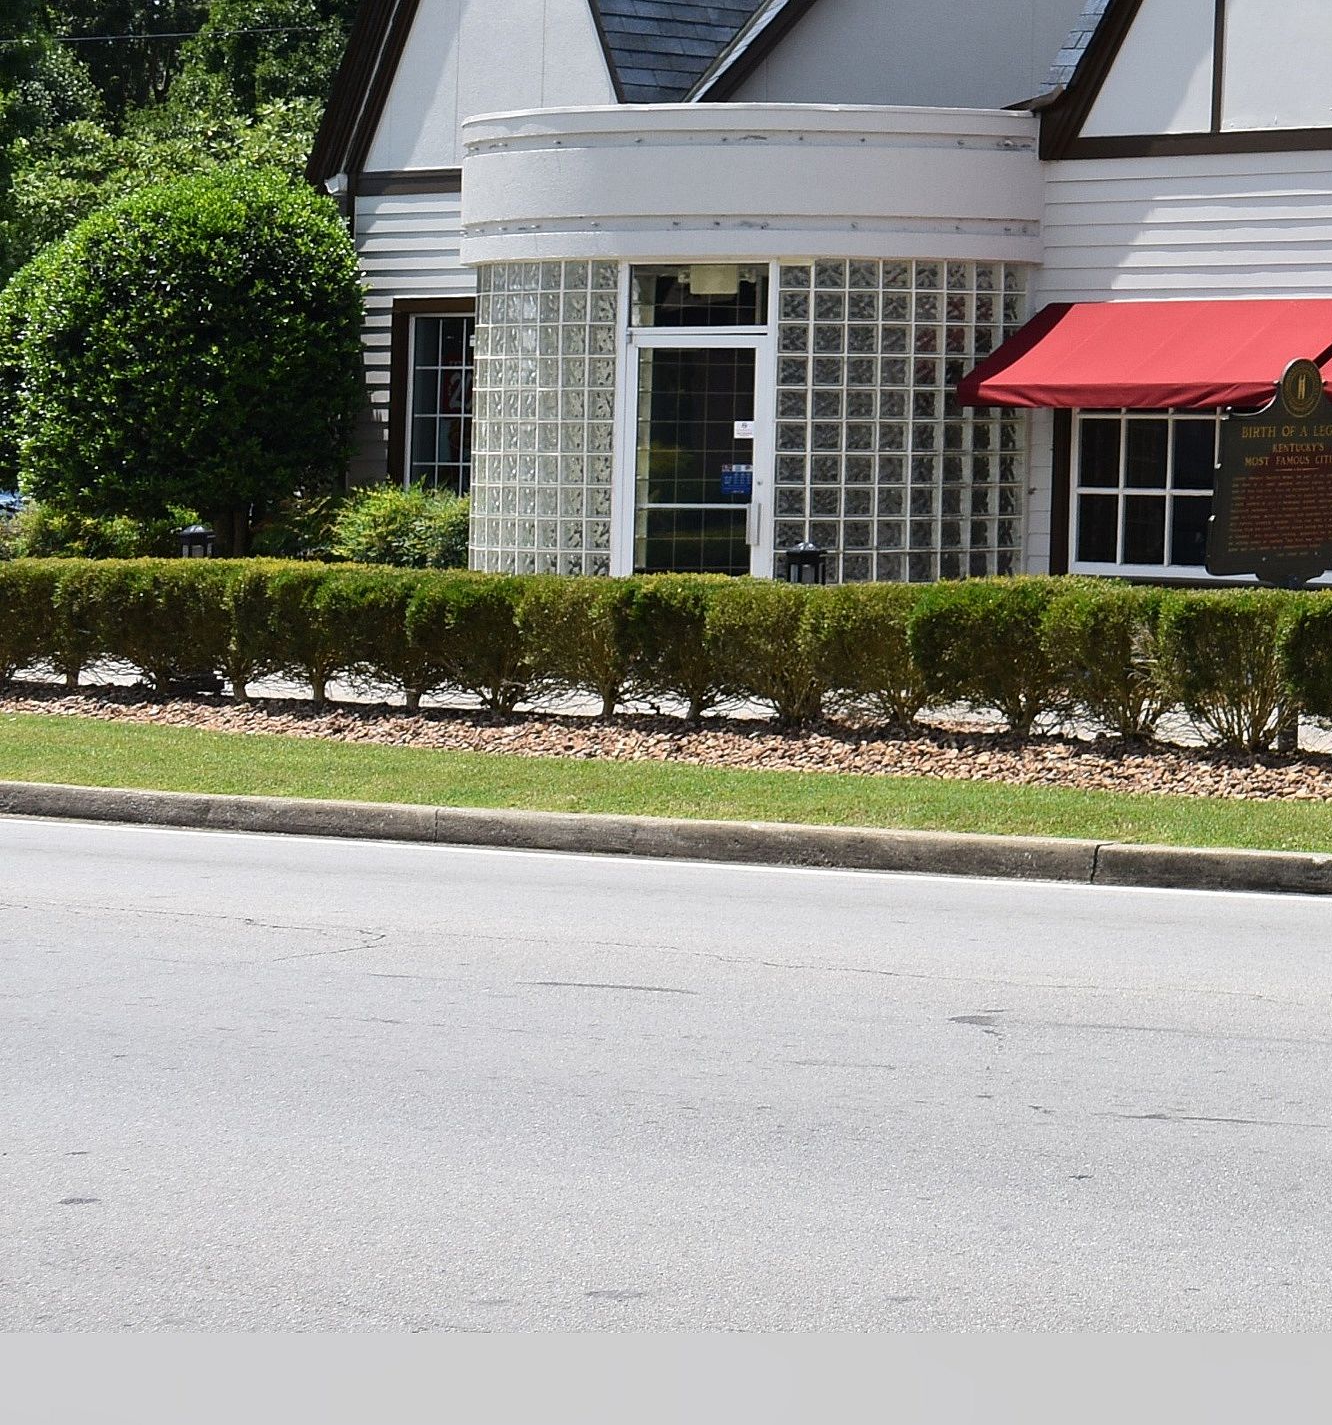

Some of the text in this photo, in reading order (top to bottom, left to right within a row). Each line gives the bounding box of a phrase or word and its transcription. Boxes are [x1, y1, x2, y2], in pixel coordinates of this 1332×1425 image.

[1241, 426, 1276, 438] BIRTH
[1282, 425, 1296, 437] OF
[1300, 425, 1308, 437] A
[1272, 442, 1325, 453] KENTUCKY'S
[1244, 456, 1269, 467] MOST
[1275, 455, 1310, 466] FAMOUS
